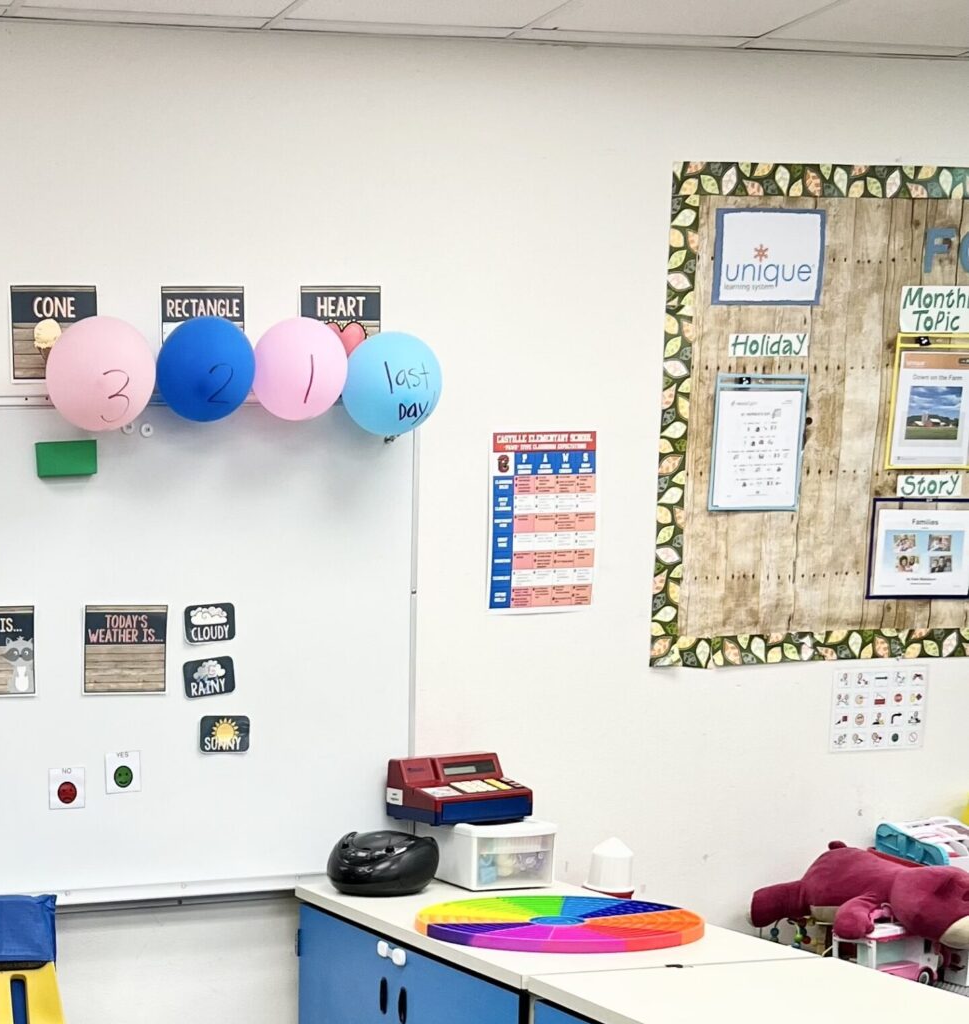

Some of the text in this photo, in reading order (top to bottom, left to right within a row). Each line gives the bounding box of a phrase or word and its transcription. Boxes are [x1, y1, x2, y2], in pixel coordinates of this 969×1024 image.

[726, 264, 812, 287] unique
[724, 283, 774, 292] learning system
[33, 296, 76, 318] CONE
[166, 298, 240, 318] RECTANGLE
[316, 296, 365, 318] HEART
[731, 333, 807, 356] Holiday
[208, 363, 233, 403] 2
[384, 361, 429, 394] last
[101, 369, 130, 423] 3
[901, 475, 960, 495] Story
[912, 518, 939, 526] Families
[0, 617, 23, 633] IS...
[105, 614, 148, 629] TODAY'S
[88, 628, 164, 643] WEATHER IS...
[190, 625, 230, 641] CLOUDY
[190, 677, 227, 697] RAINY
[204, 736, 242, 751] SUNNY
